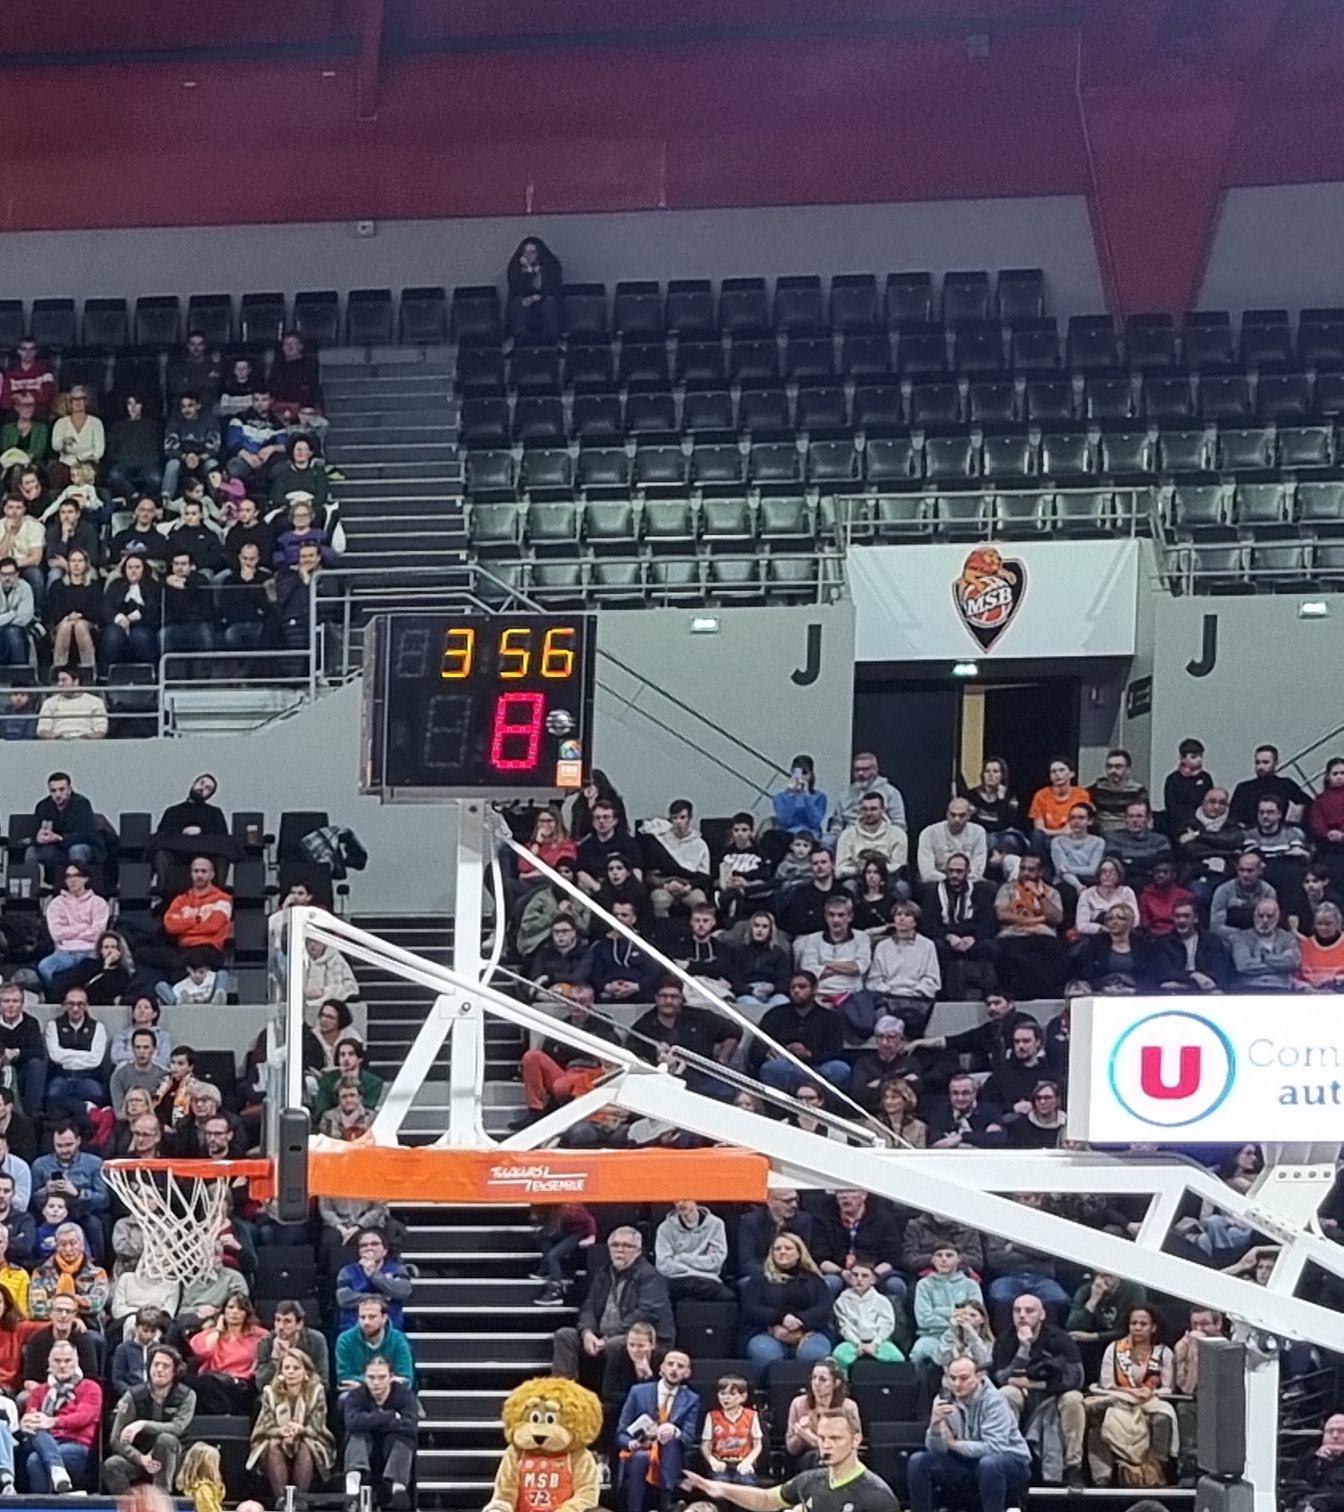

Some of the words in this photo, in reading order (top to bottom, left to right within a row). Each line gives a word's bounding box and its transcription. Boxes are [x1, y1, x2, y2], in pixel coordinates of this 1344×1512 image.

[967, 586, 1012, 616] MSB
[440, 627, 474, 678] 3
[498, 627, 575, 679] 56
[790, 624, 822, 686] J
[1185, 614, 1218, 678] J
[491, 692, 544, 769] 8
[1140, 1046, 1202, 1101] U
[524, 1472, 560, 1489] MSB
